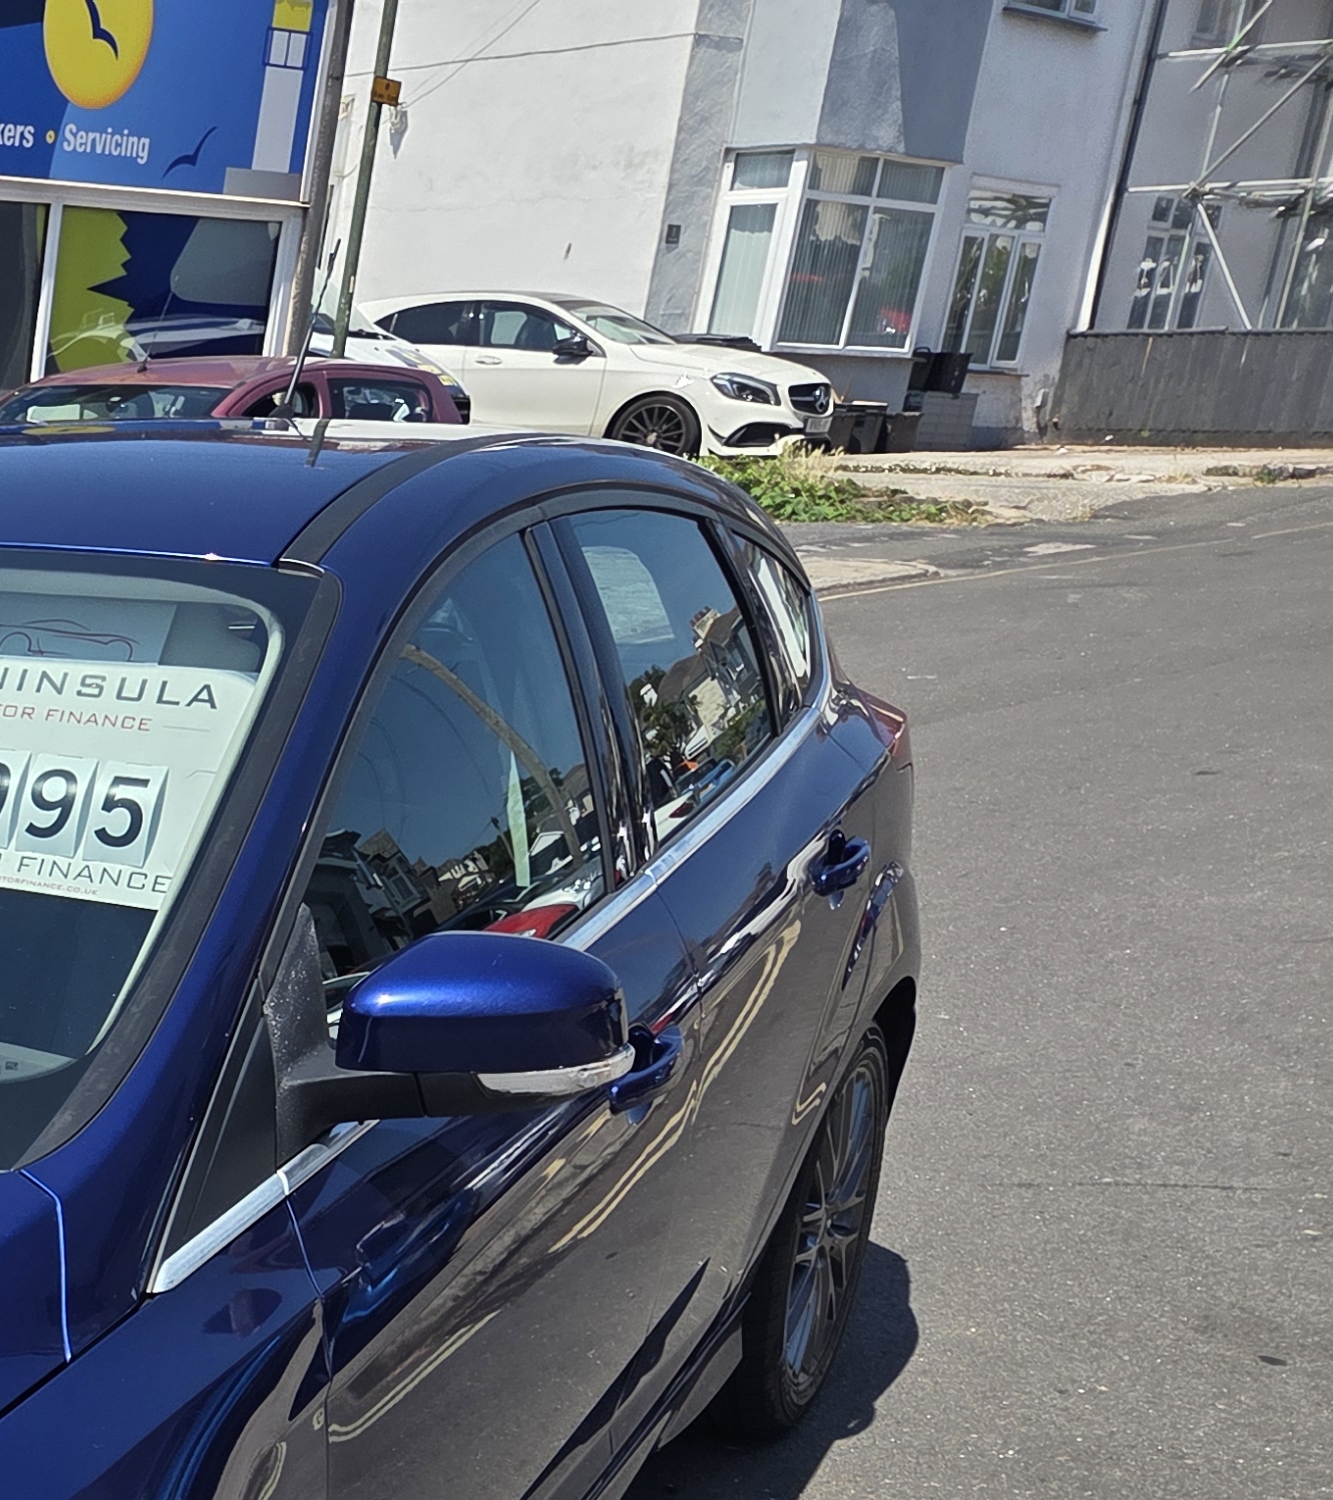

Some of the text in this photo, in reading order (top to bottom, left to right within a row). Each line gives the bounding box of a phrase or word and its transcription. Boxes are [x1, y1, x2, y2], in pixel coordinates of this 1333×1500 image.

[62, 123, 150, 165] Servicing
[44, 707, 153, 732] FINANCE
[17, 855, 173, 894] FINANCE
